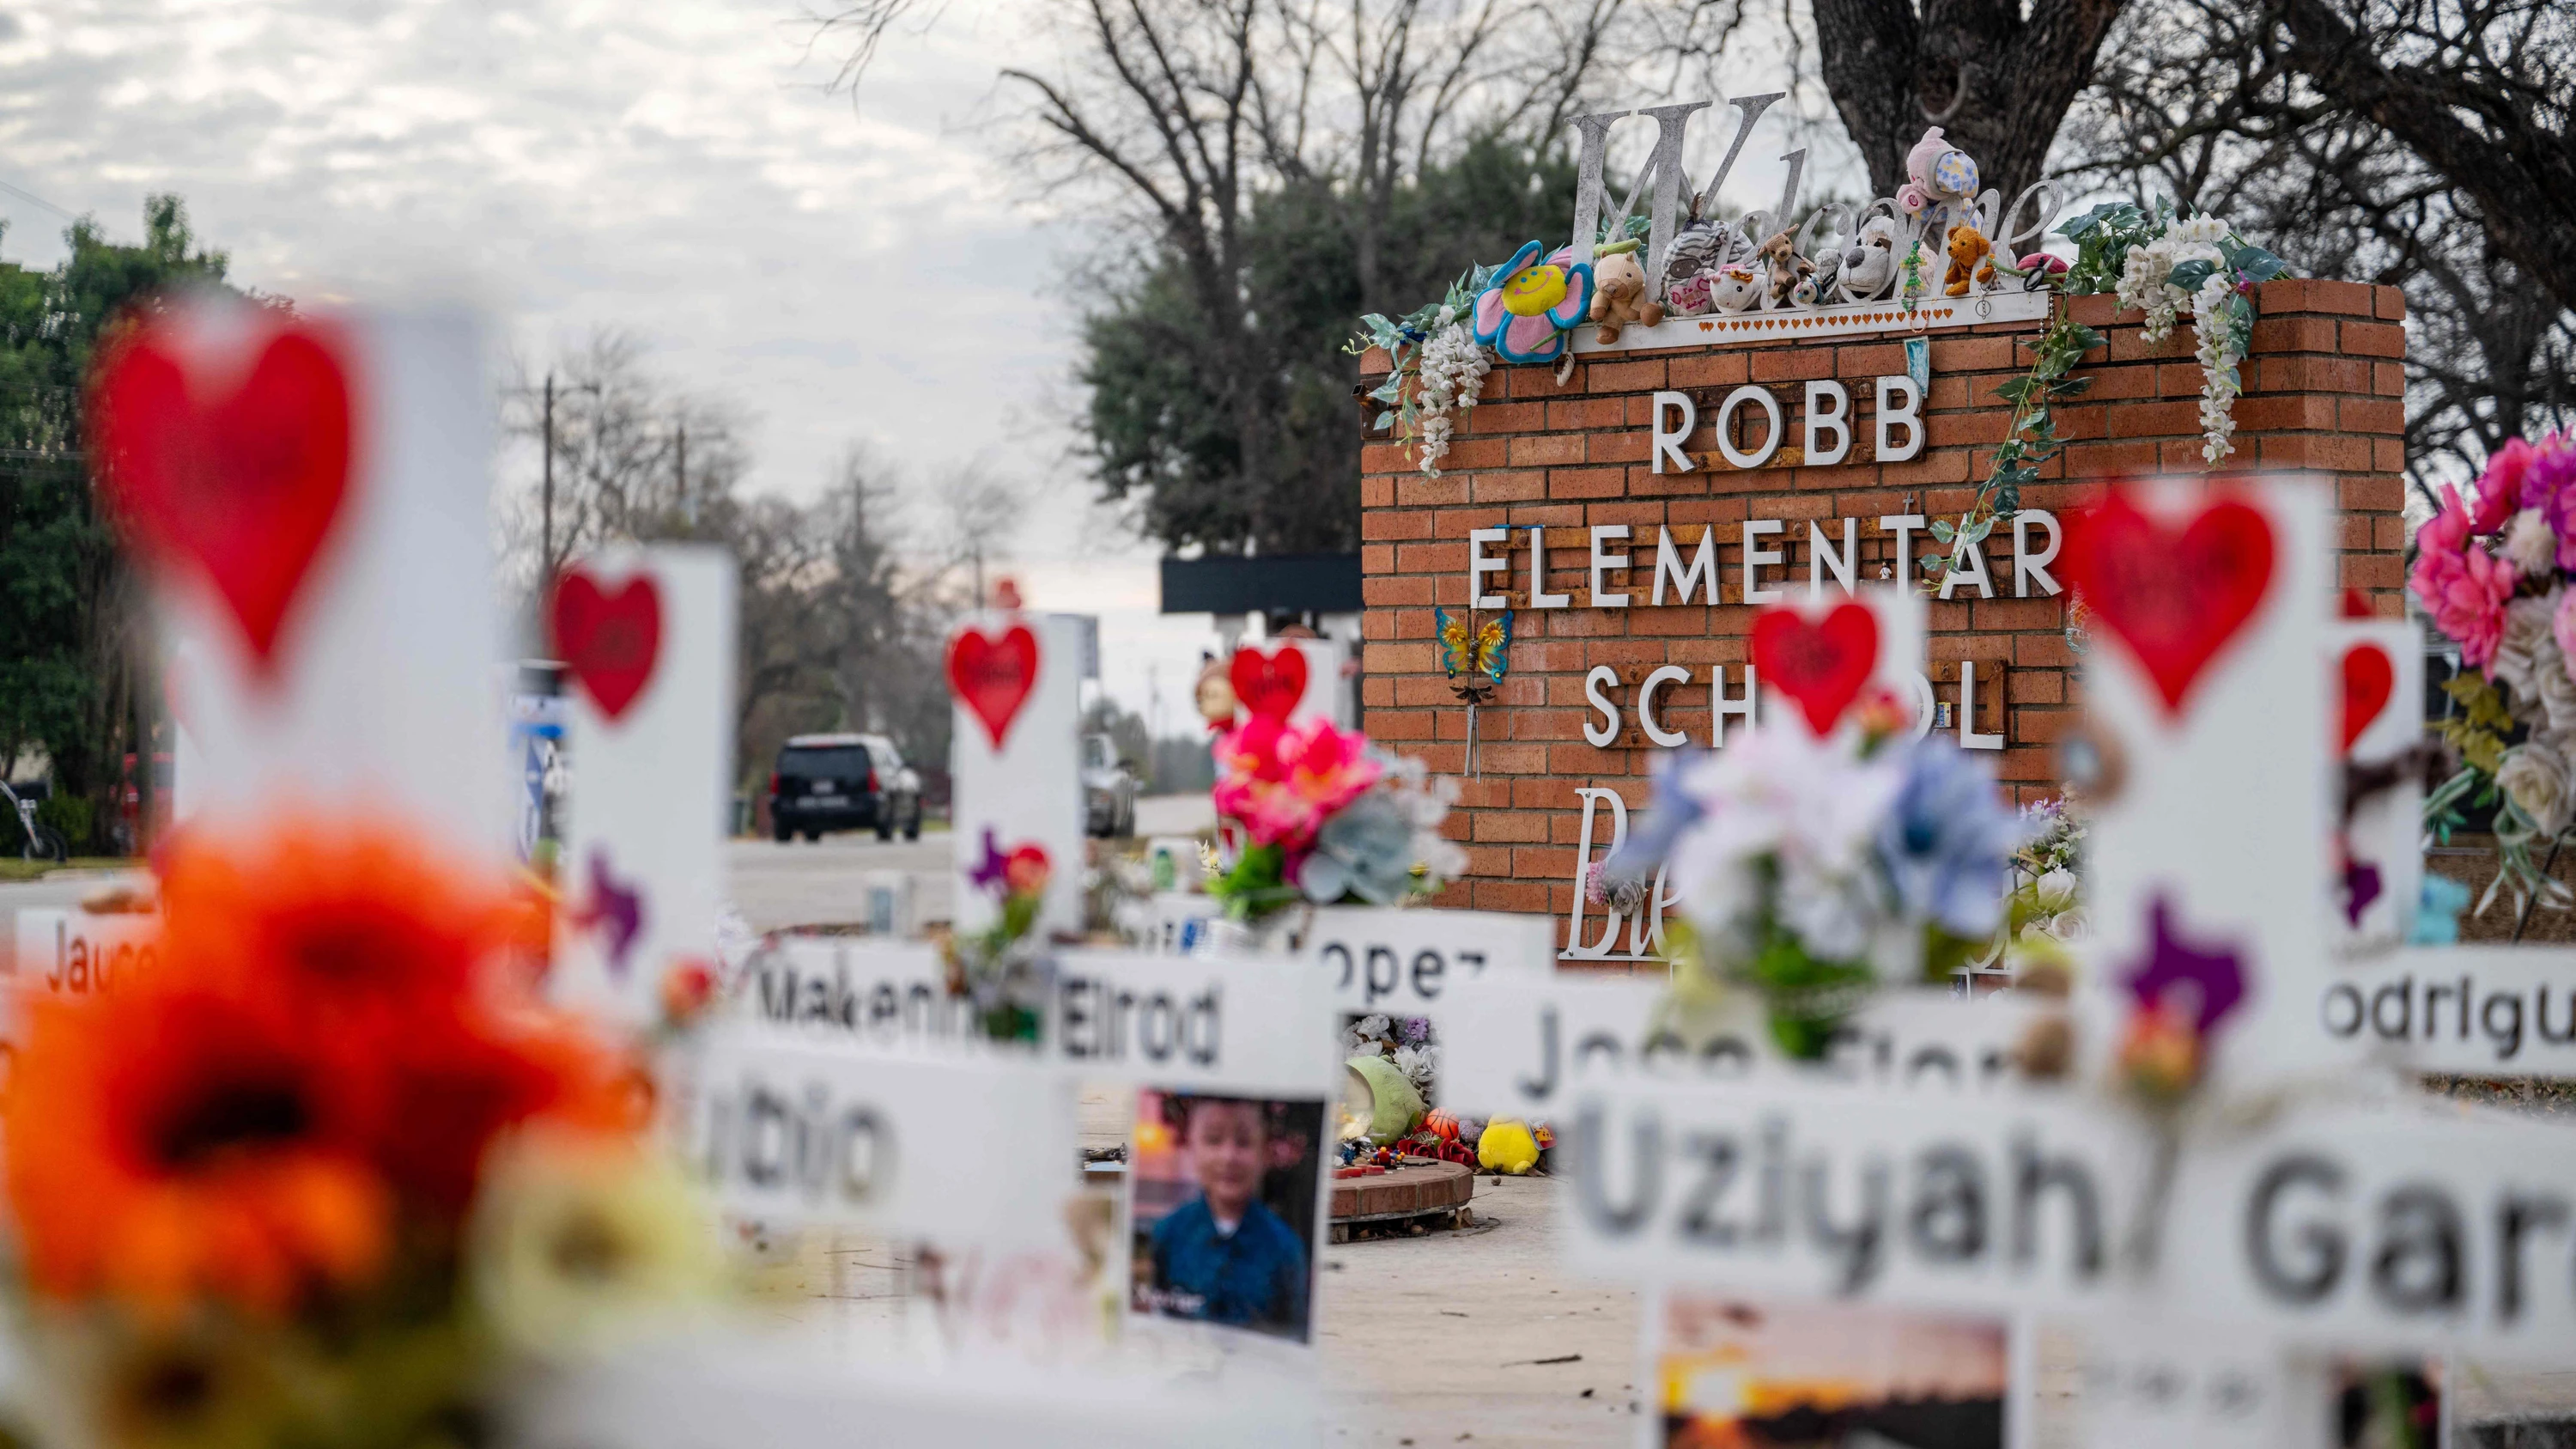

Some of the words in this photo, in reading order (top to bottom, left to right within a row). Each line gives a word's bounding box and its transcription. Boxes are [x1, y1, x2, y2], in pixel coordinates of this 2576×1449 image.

[1564, 91, 2063, 307] Welcome
[1651, 376, 1925, 474] ROBB
[1470, 509, 2066, 609] ELEMENTAR
[1583, 661, 2007, 750] SCHL
[1060, 979, 1221, 1065] Elrod
[2325, 971, 2576, 1060] odrigu
[1573, 1093, 2102, 1294] Uziyah
[2243, 1148, 2576, 1328] Gar
